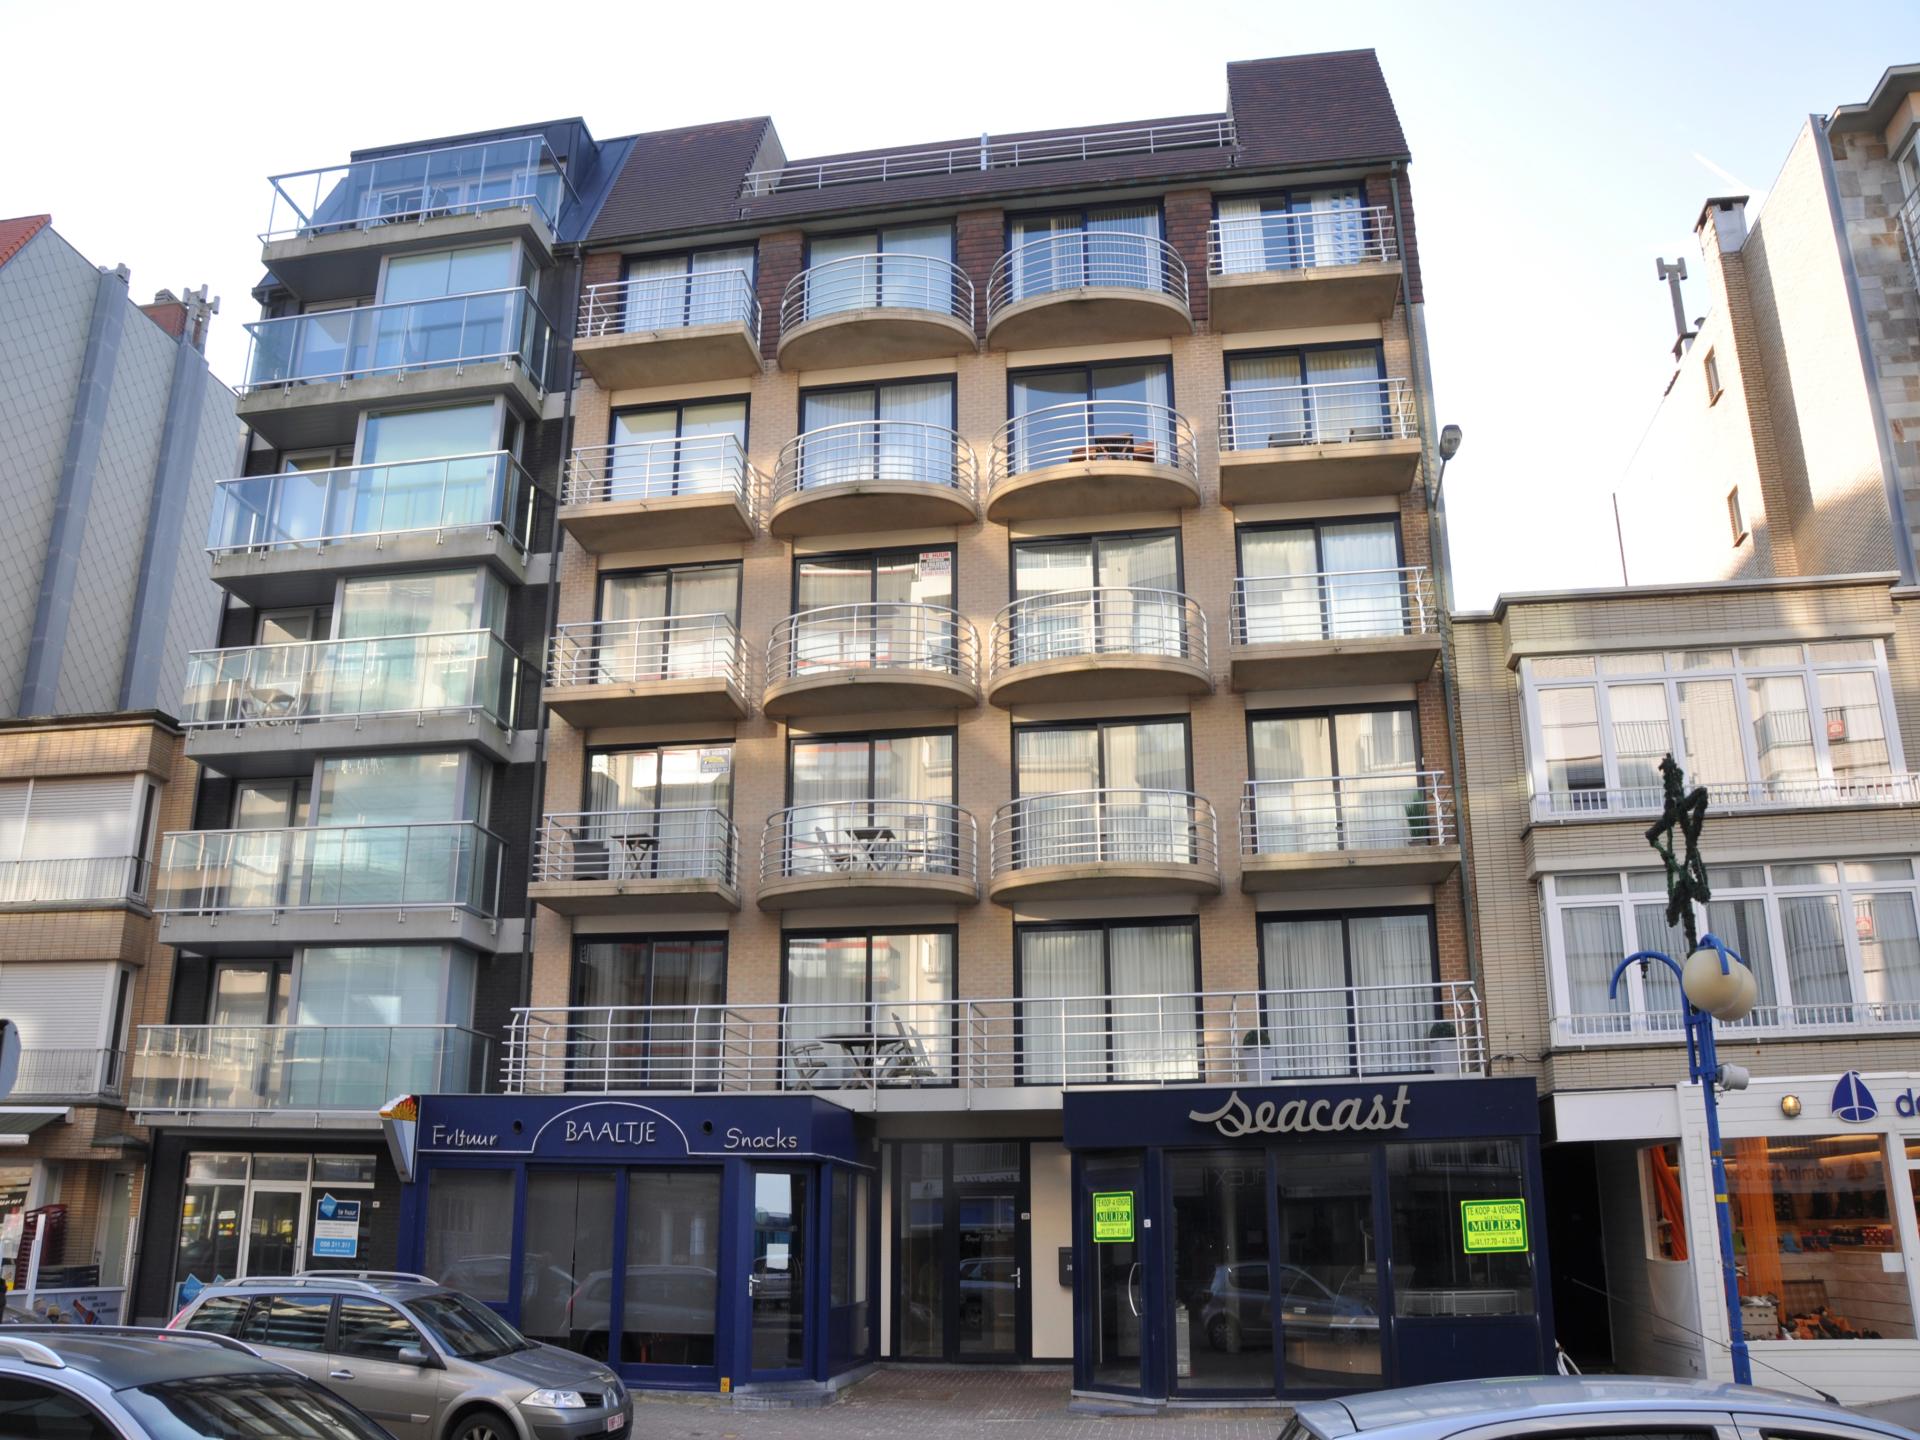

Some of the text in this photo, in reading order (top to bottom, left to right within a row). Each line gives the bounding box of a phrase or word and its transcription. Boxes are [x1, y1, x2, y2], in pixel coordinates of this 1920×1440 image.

[1189, 1085, 1411, 1137] Seacast
[1895, 1087, 1920, 1118] d
[565, 1120, 656, 1145] BAALTJE
[723, 1122, 798, 1149] Snacks
[1098, 1211, 1129, 1221] MULIER
[1467, 1207, 1474, 1216] TE
[1475, 1206, 1490, 1215] KOOP
[1498, 1205, 1520, 1214] VENDRE
[1471, 1219, 1518, 1231] MULIER
